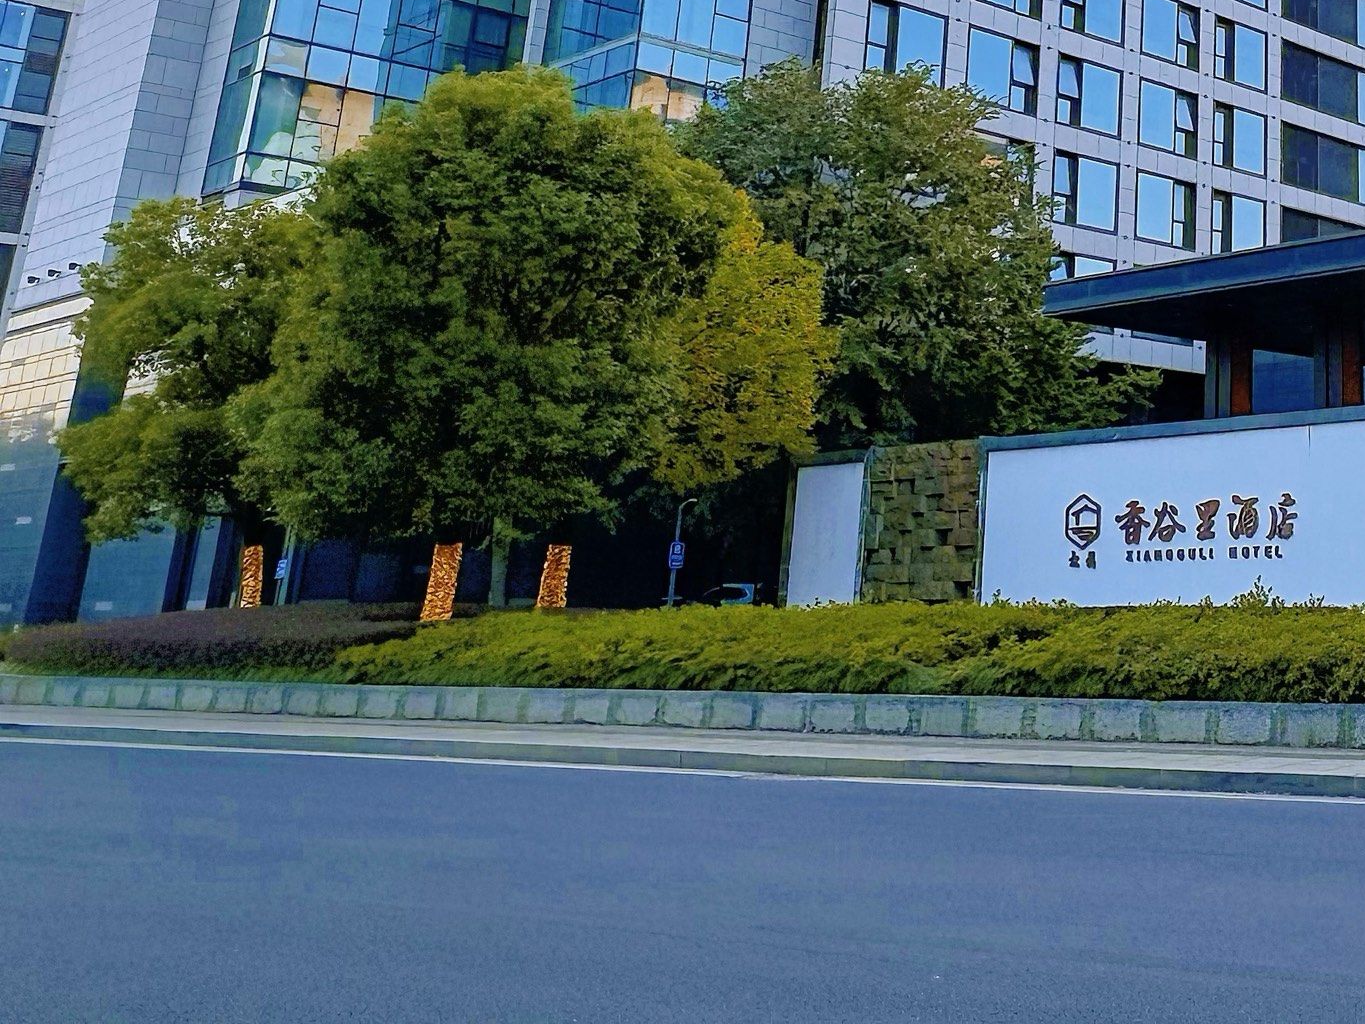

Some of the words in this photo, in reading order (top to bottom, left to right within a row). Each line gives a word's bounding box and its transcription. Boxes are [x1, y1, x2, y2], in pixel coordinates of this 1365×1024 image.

[1115, 492, 1298, 545] 香谷里酒店
[1228, 545, 1283, 559] HOTEL
